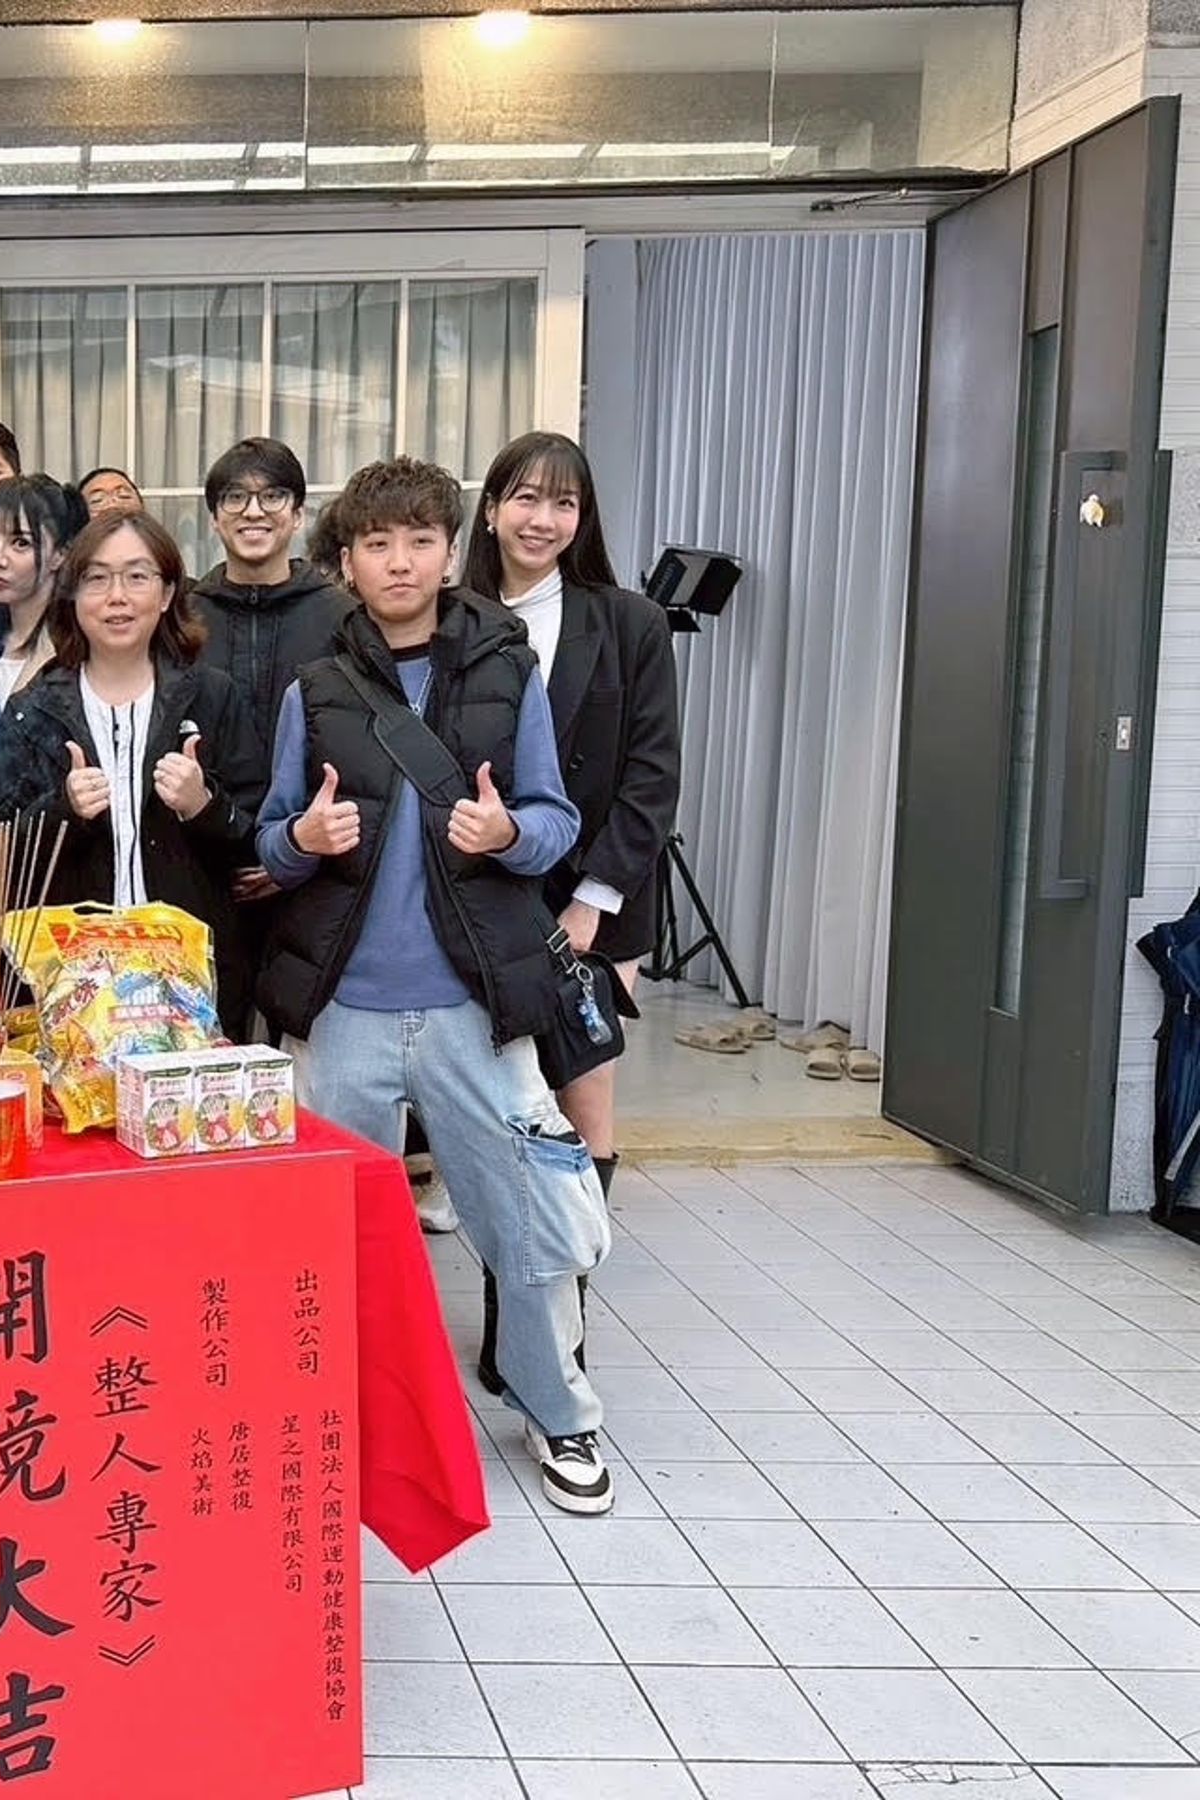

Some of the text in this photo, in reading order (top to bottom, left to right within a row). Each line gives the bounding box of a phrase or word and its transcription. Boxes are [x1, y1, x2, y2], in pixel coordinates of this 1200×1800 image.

[200, 1279, 229, 1387] 製作公司
[294, 1270, 320, 1374] 出品公司
[90, 1305, 162, 1667] 《整人專家》
[191, 1428, 213, 1516] 火焰美術
[281, 1415, 304, 1593] 星之國際有限公司
